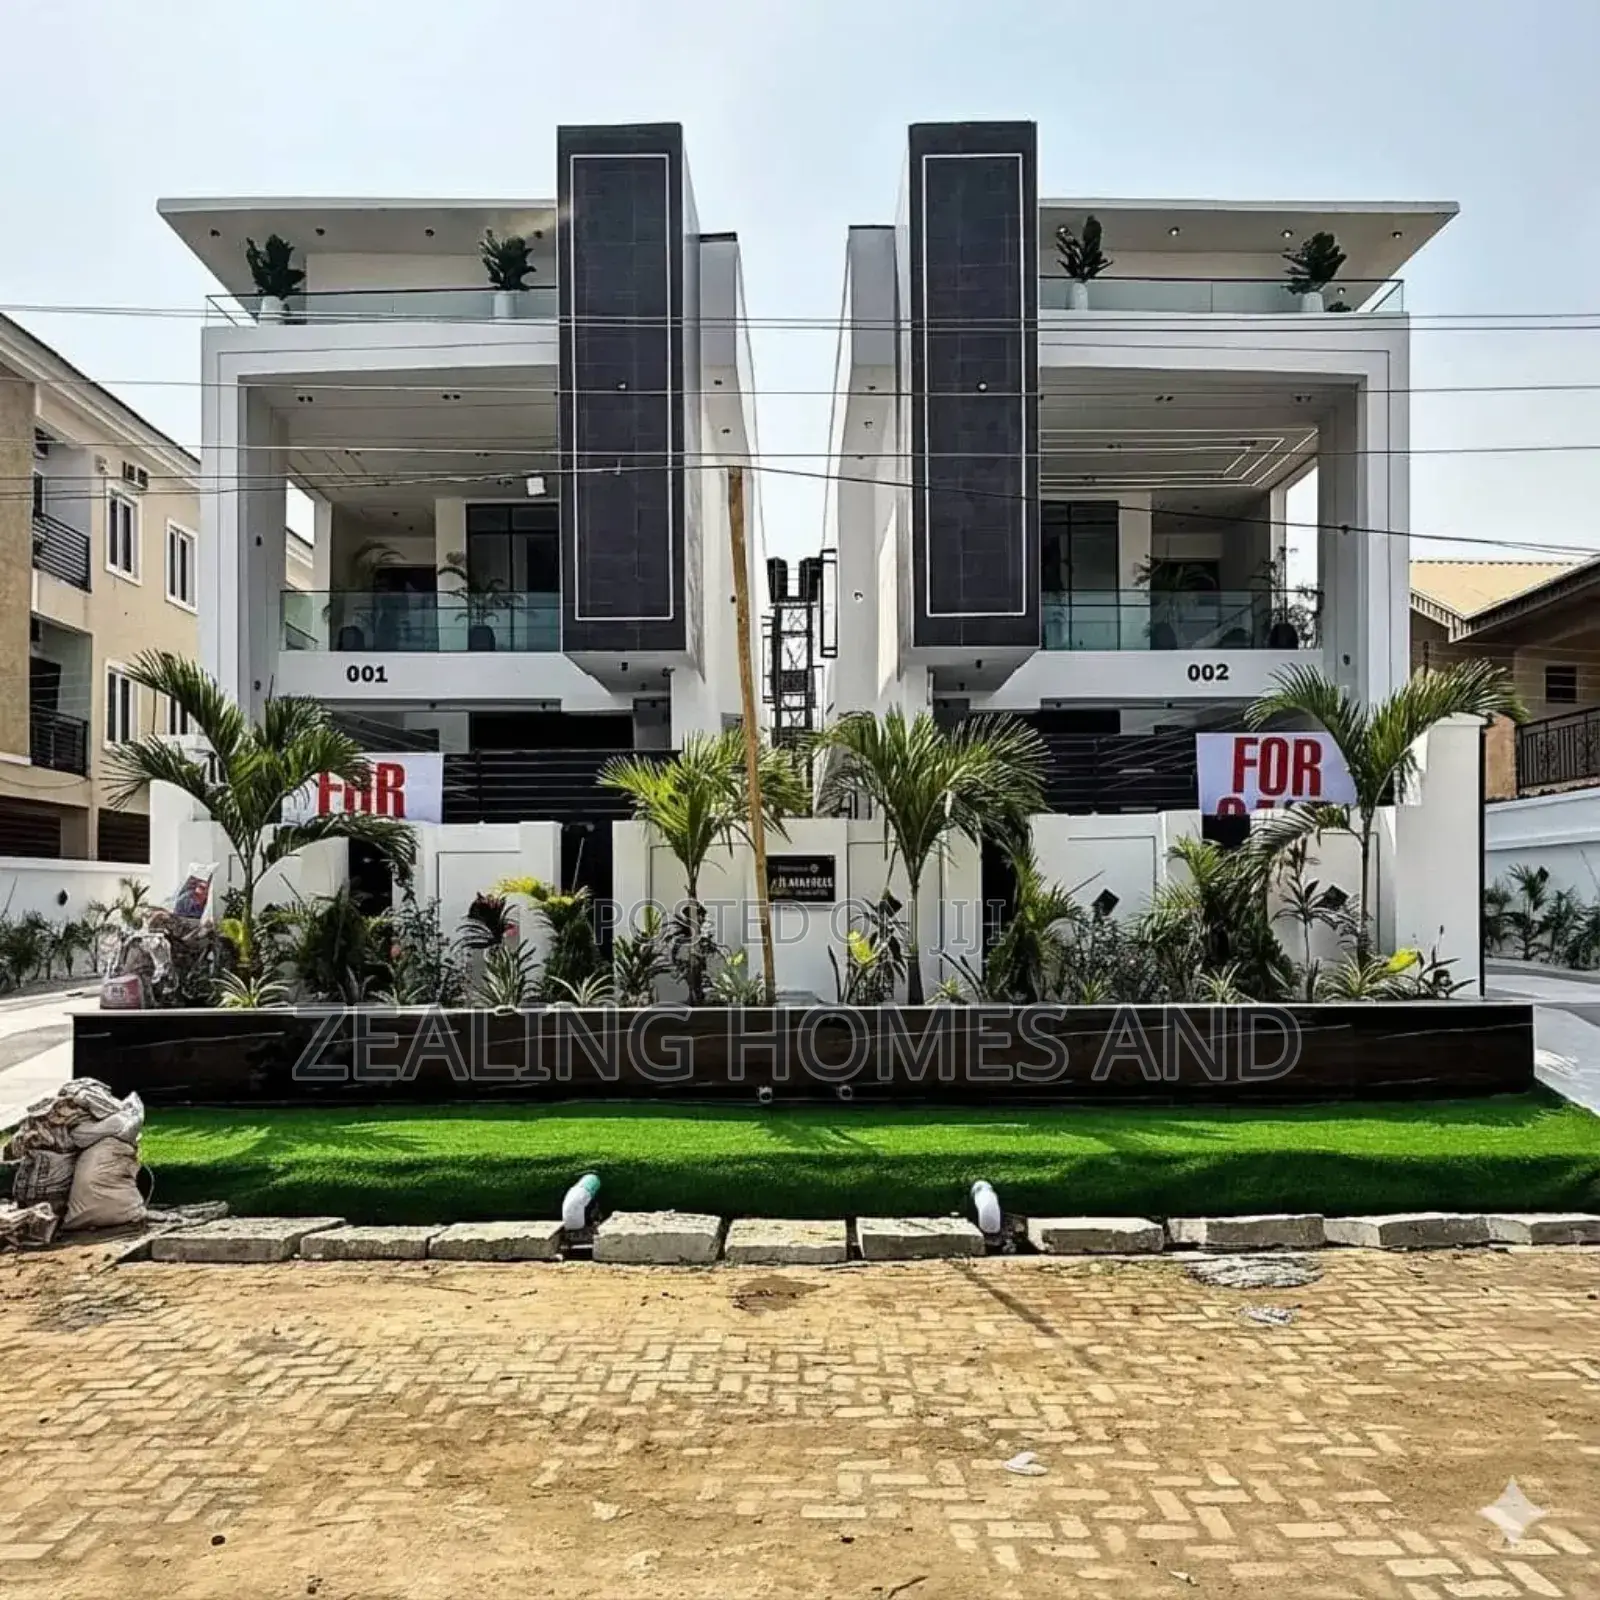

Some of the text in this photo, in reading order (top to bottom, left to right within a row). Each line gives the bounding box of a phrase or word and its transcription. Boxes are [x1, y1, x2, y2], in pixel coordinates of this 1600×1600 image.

[346, 665, 388, 683] 001
[1187, 664, 1229, 681] 002
[1232, 736, 1322, 797] FOR
